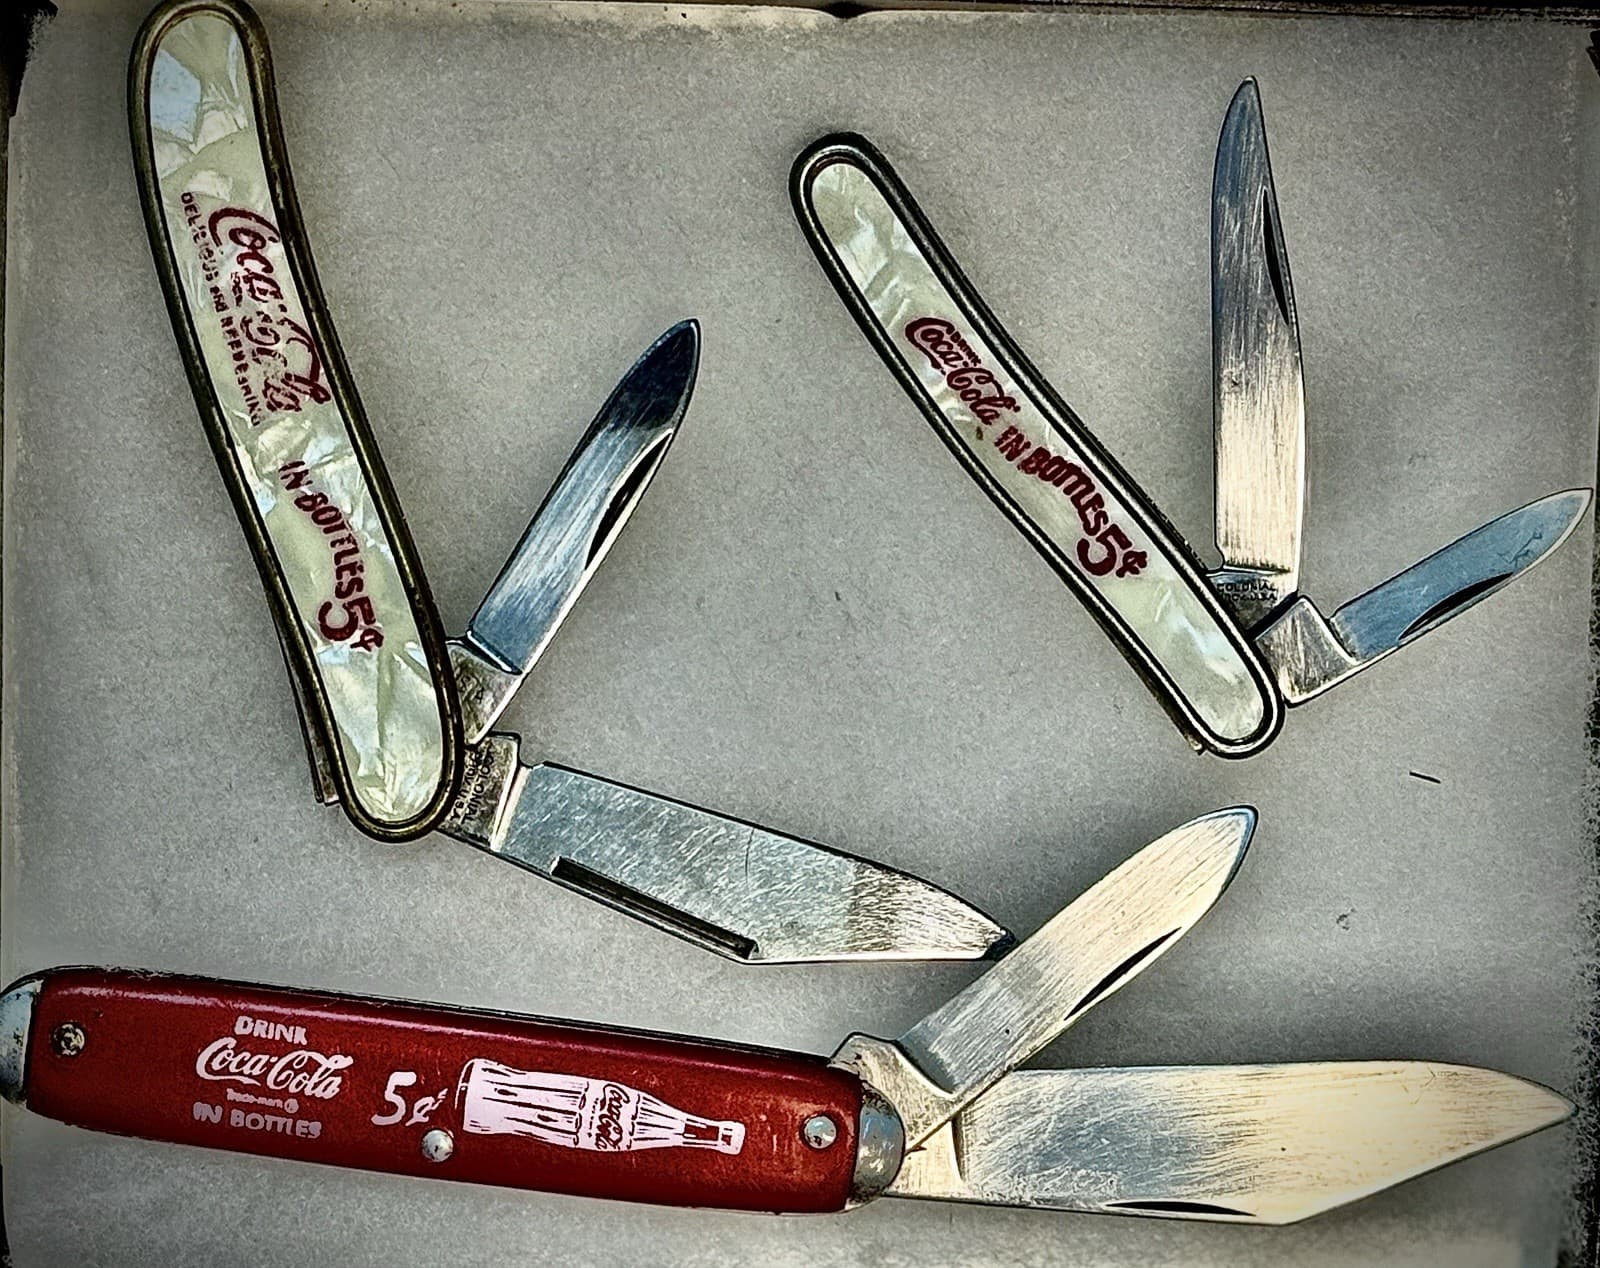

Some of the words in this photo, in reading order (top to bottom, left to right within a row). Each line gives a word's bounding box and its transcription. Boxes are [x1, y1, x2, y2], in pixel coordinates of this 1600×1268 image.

[905, 317, 1021, 426] Coca-Cola
[278, 460, 313, 491] IN
[994, 425, 1031, 462] IN
[1017, 446, 1109, 536] BOTTLES
[294, 491, 365, 600] BOTTLES
[234, 1015, 307, 1046] DRINK
[196, 1036, 354, 1100] Coca-Cola
[193, 1101, 223, 1124] IN
[229, 1109, 322, 1139] BOTTLES
